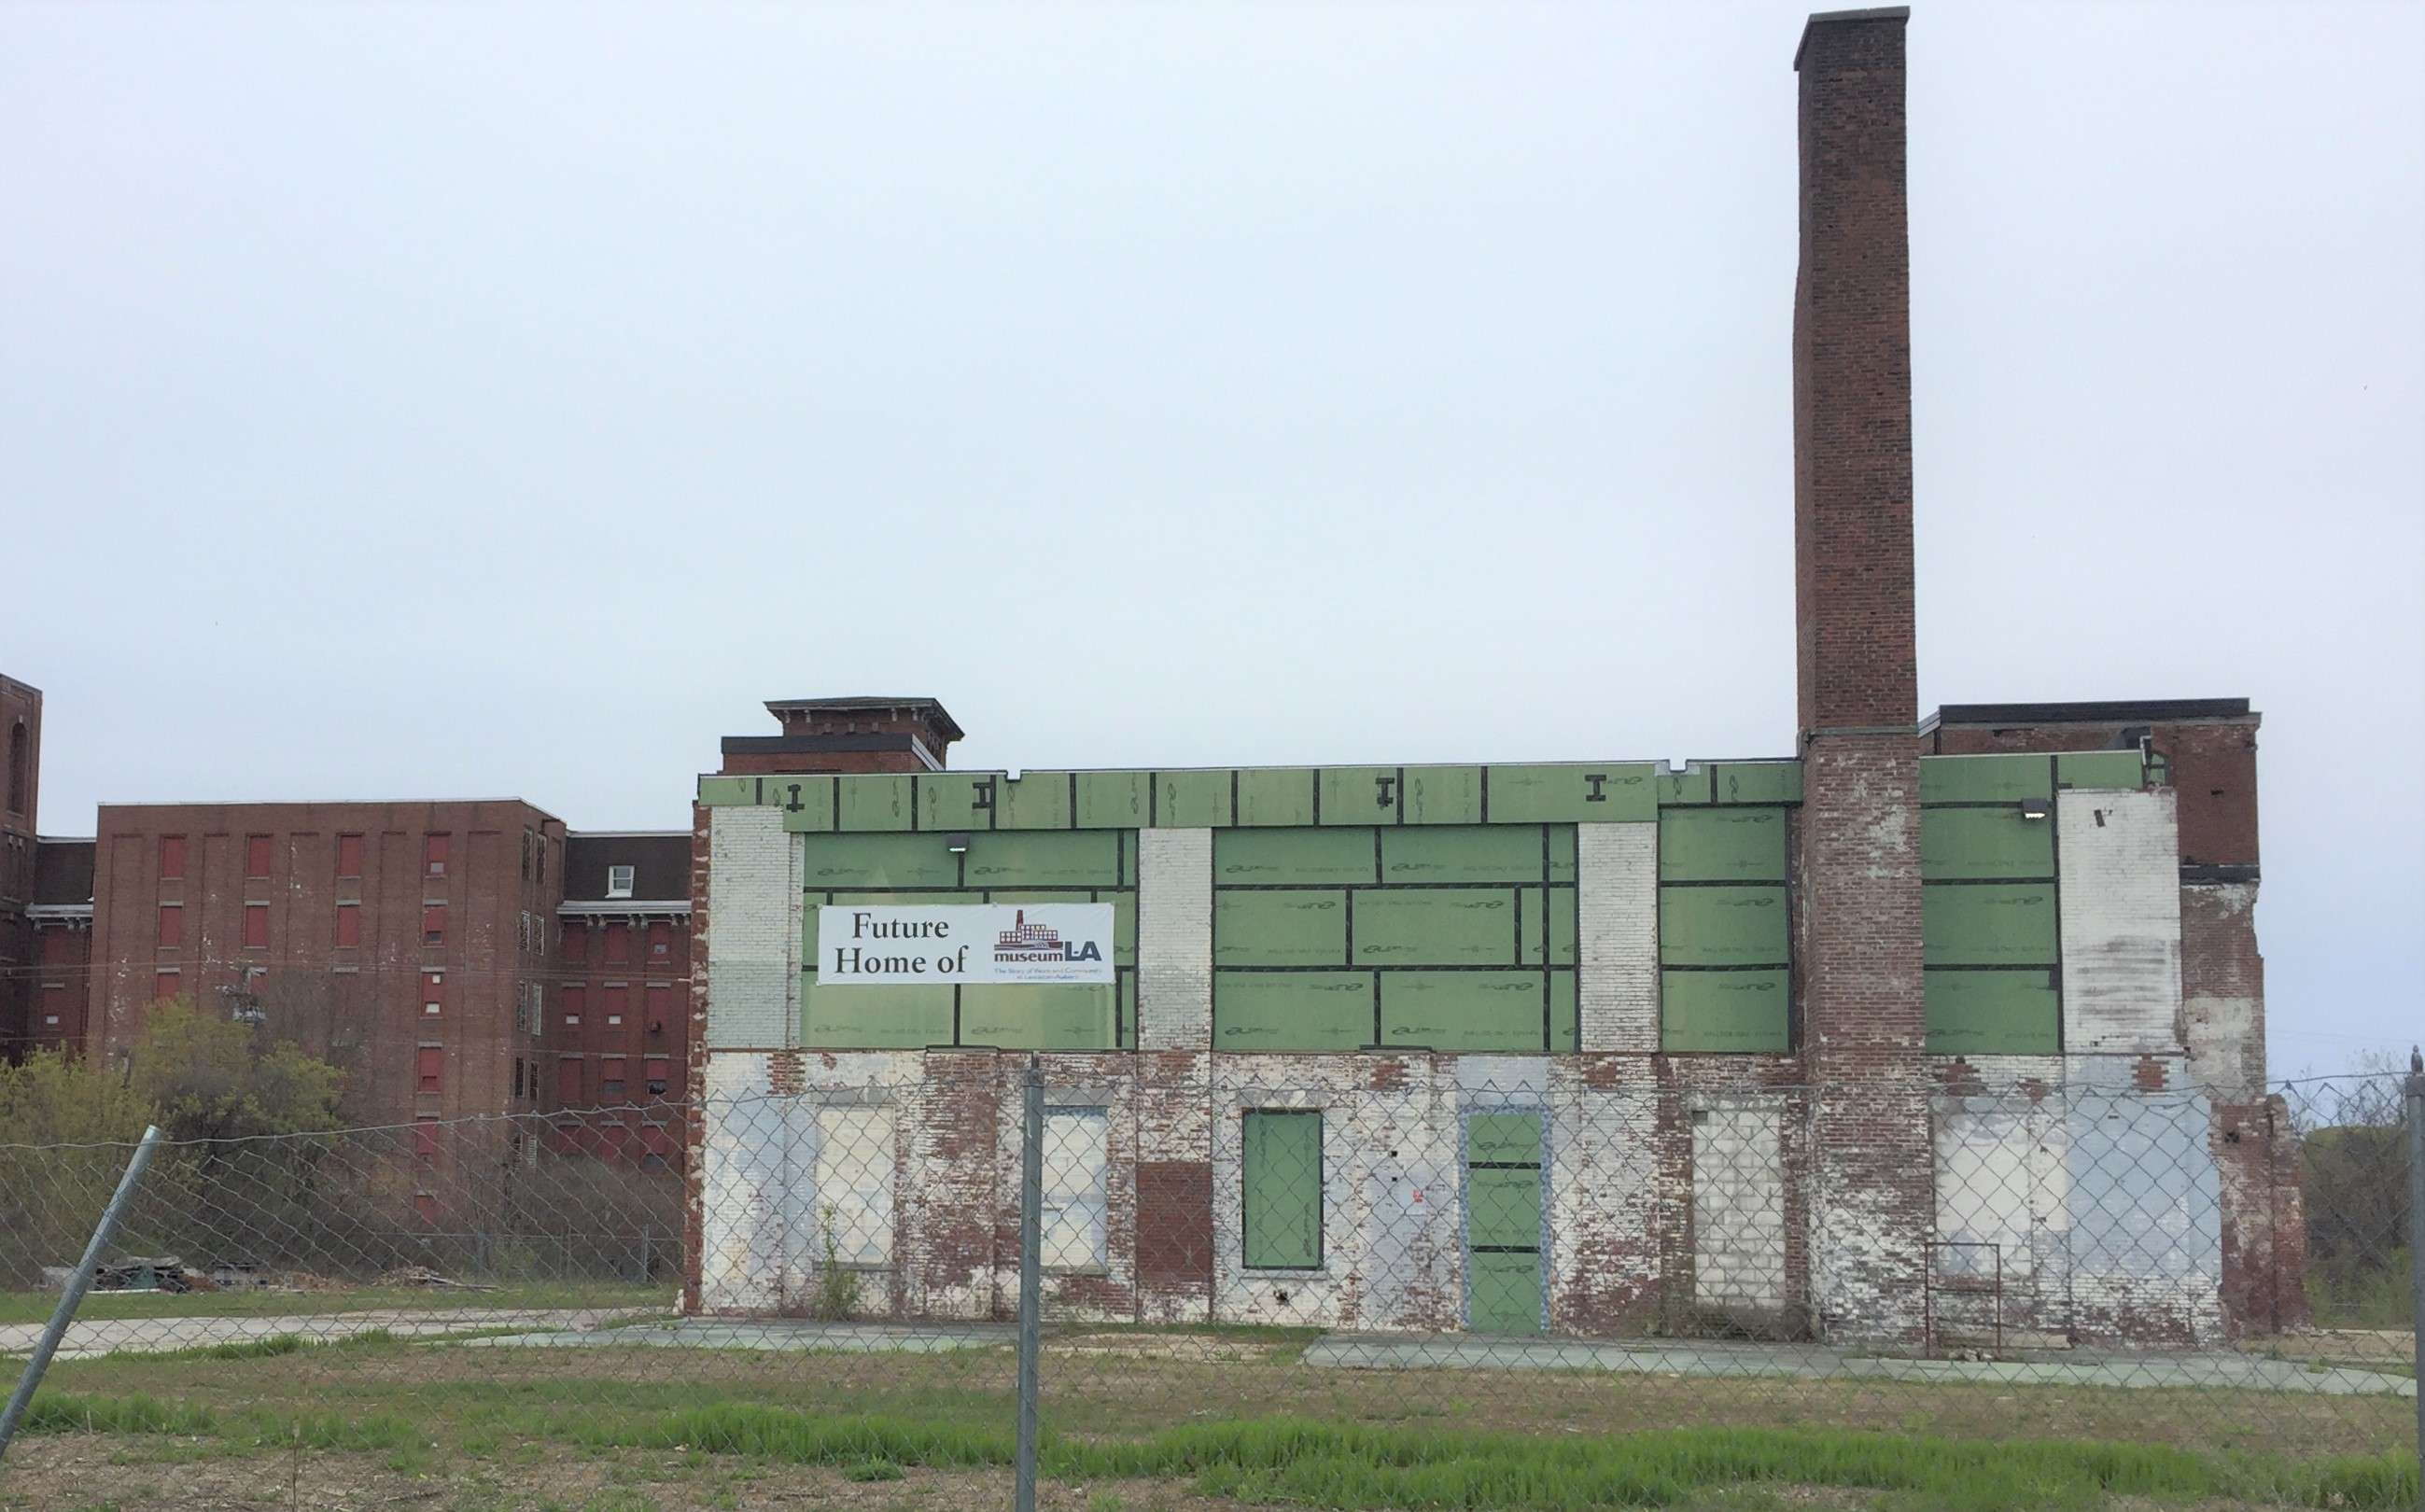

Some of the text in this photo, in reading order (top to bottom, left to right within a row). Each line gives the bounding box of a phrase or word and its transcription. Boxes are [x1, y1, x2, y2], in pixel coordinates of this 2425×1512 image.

[851, 911, 950, 939] Future
[834, 945, 970, 973] Home of
[994, 952, 1063, 962] museum
